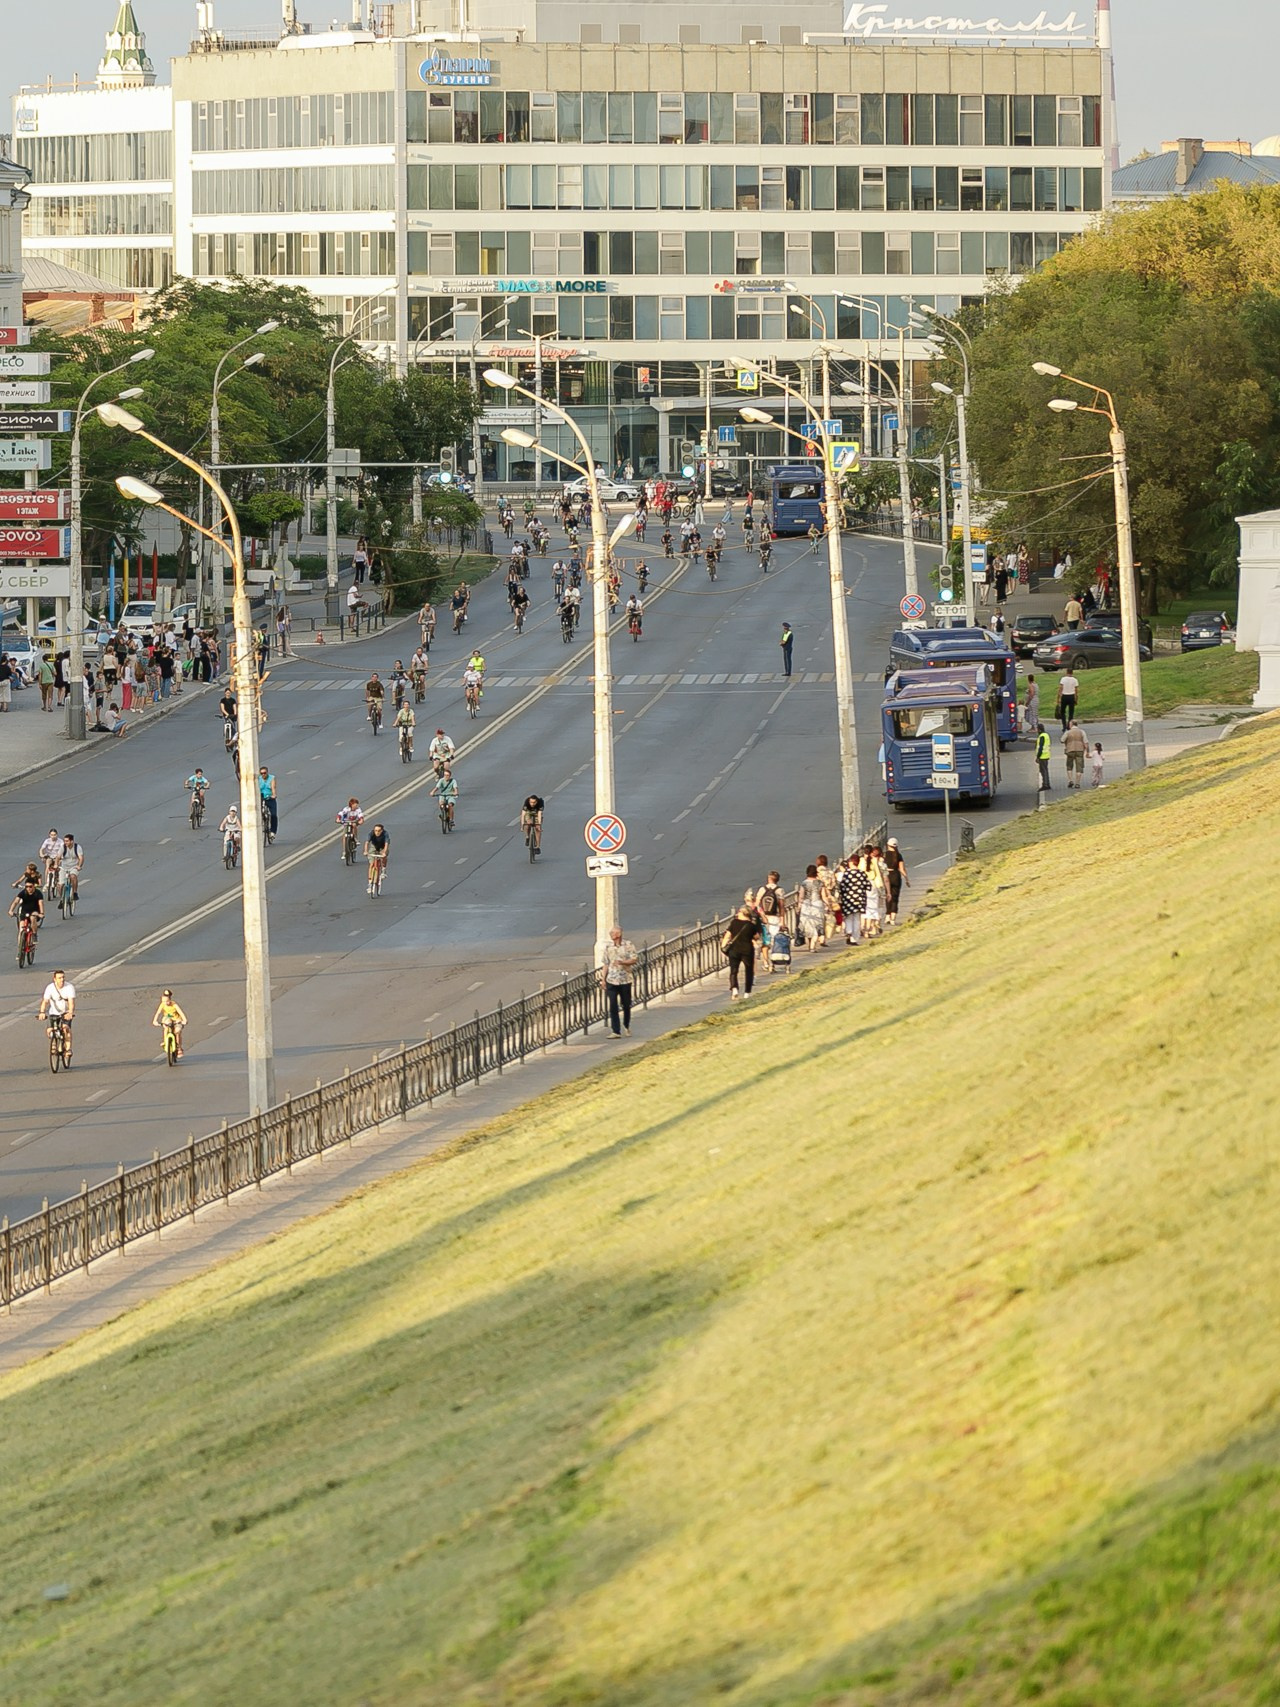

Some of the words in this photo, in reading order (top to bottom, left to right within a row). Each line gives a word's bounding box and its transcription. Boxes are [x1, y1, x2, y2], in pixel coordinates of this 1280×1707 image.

[843, 3, 1086, 37] Кристалл
[442, 76, 490, 84] БУРЕНИЕ
[498, 280, 539, 292] MAC
[556, 281, 607, 292] MORE
[12, 447, 37, 455] Lake
[0, 495, 55, 504] ROSTIC'S
[21, 507, 39, 515] ЭТАЖ
[8, 576, 49, 588] СБЕР
[936, 607, 966, 615] СТОП
